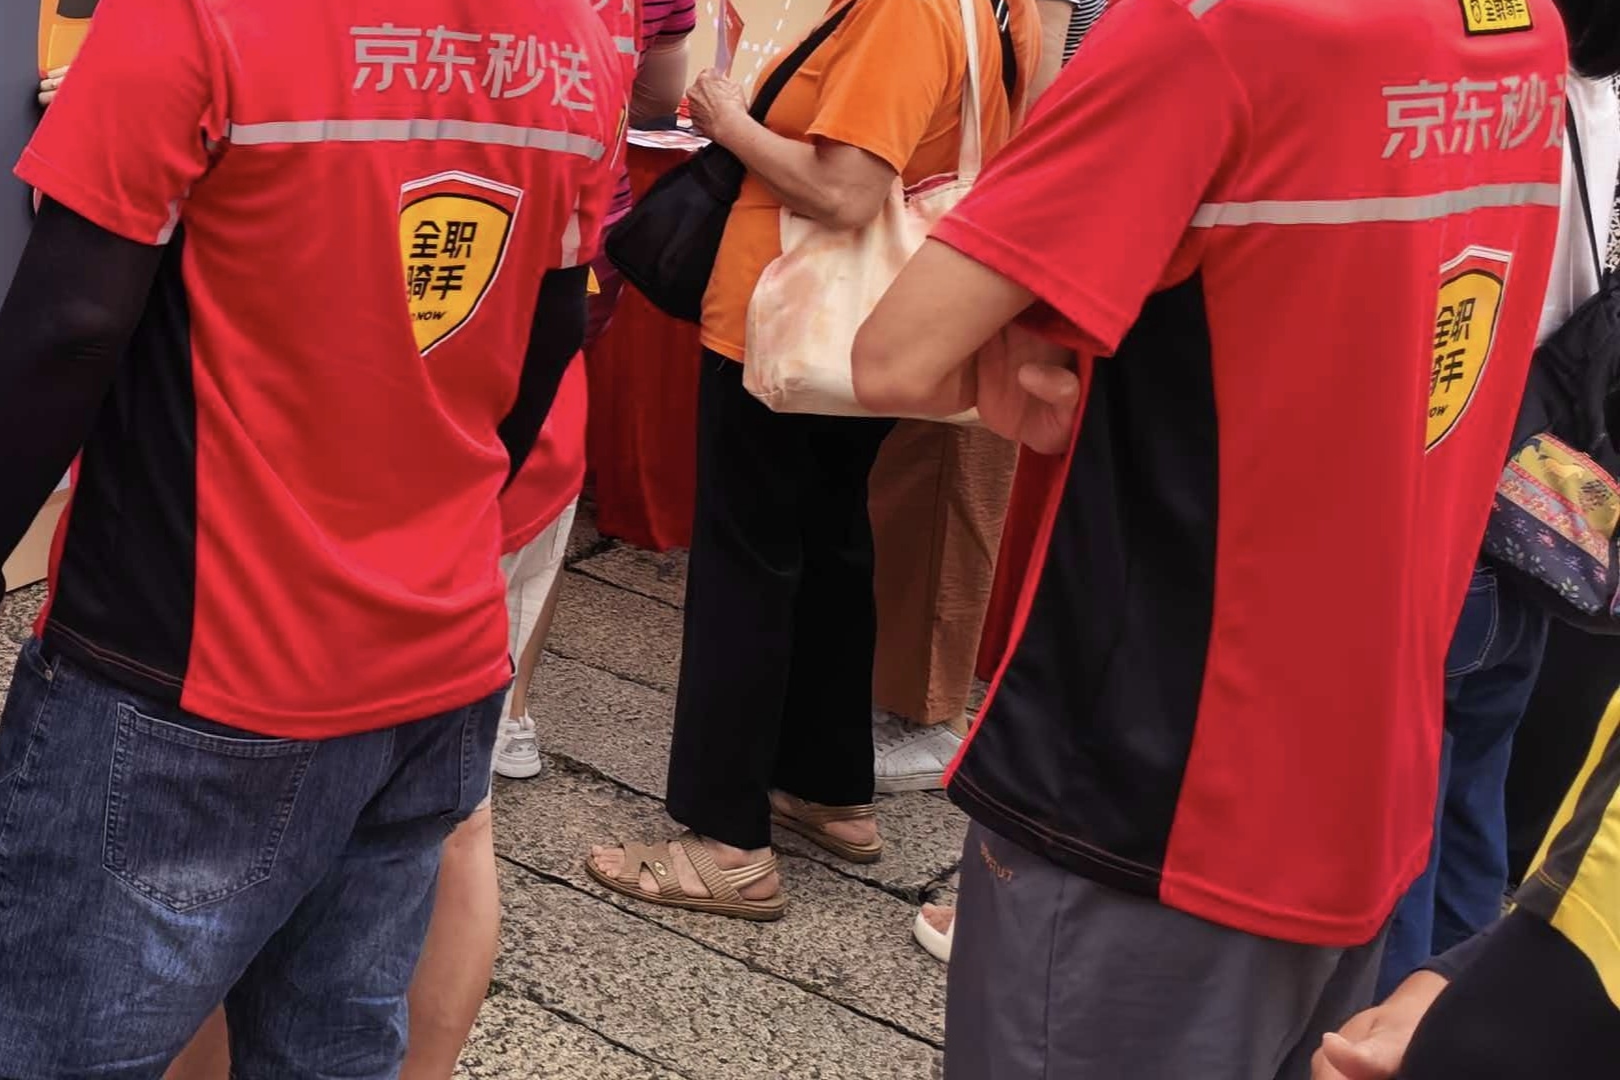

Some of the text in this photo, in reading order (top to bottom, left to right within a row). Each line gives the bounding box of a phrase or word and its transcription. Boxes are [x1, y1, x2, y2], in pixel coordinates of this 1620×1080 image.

[350, 22, 595, 111] 京东秒送
[409, 220, 478, 259] 全职
